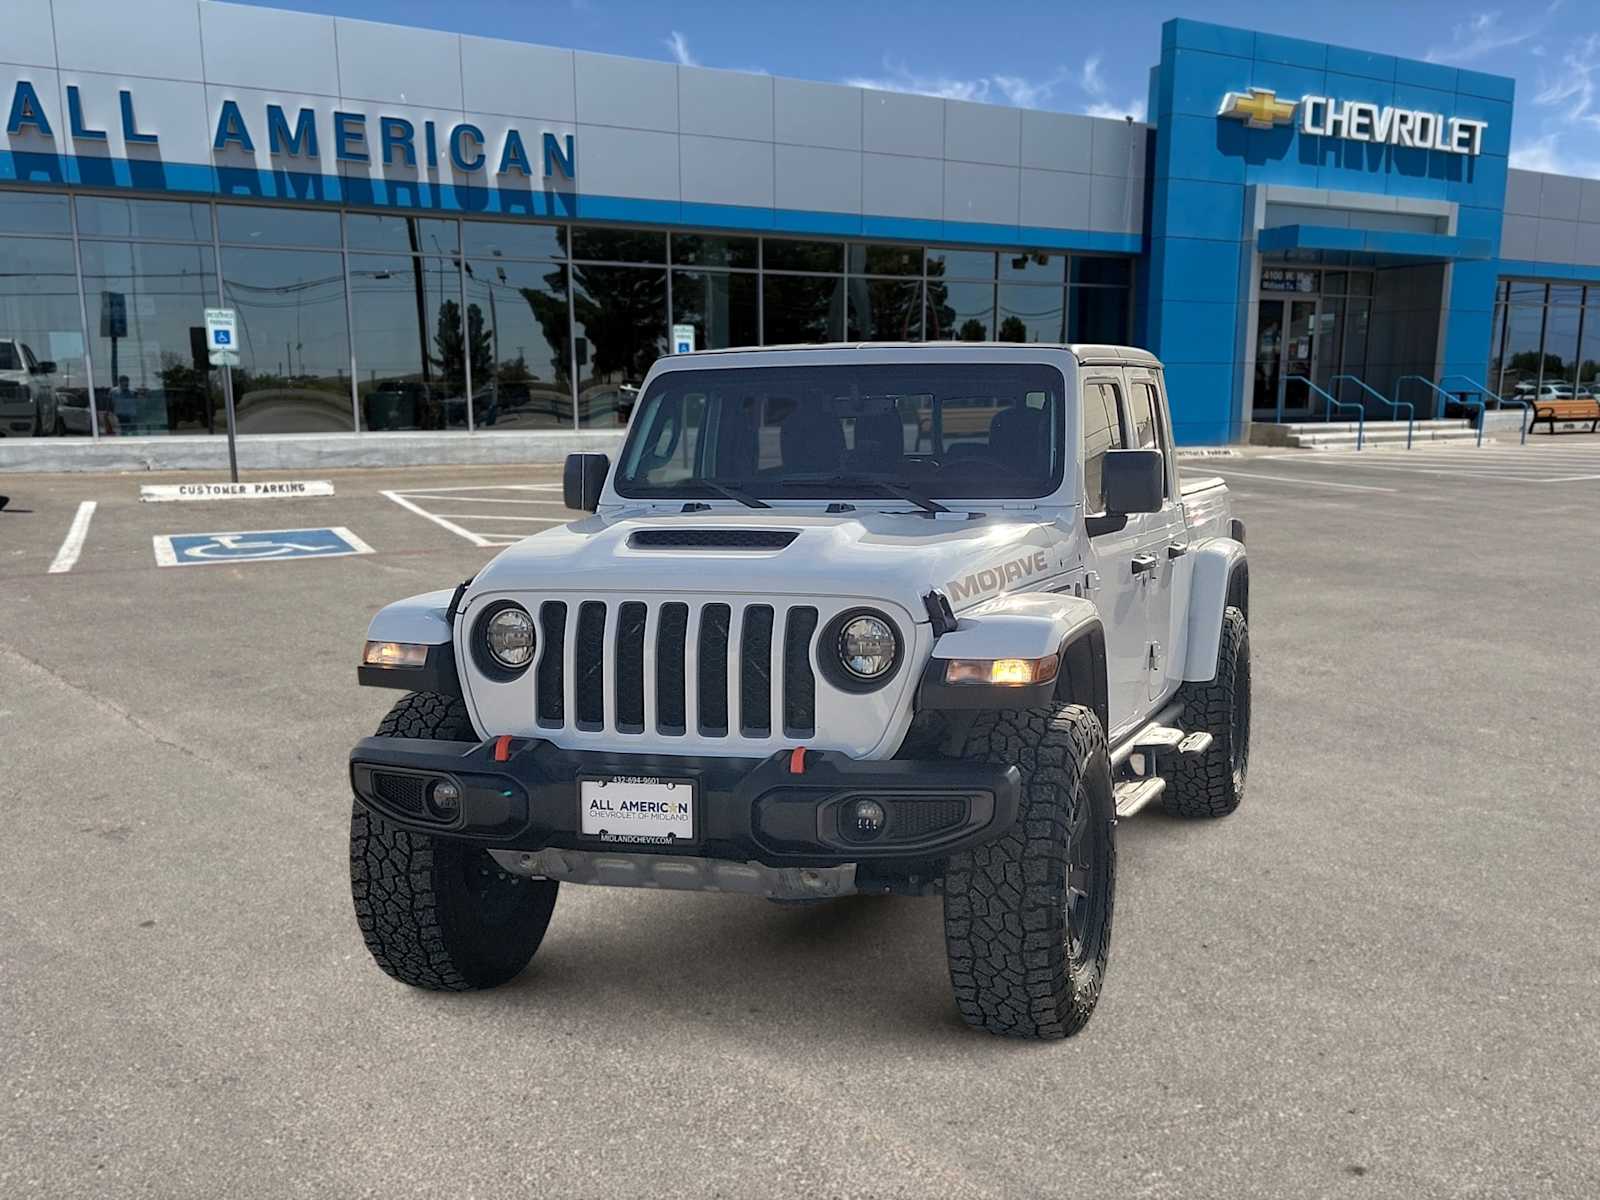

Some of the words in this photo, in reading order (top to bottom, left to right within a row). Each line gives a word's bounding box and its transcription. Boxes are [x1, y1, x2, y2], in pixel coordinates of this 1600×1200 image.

[6, 80, 159, 144] ALL
[213, 99, 576, 178] AMERICAN
[1301, 94, 1488, 156] CHEVROLET
[179, 485, 247, 495] CUSTOMER
[254, 482, 306, 493] PARKING
[946, 551, 1048, 601] MOJAVE
[590, 800, 614, 811] ALL
[620, 801, 688, 814] AMERICN
[590, 810, 635, 819] CHEVROLET
[639, 812, 649, 820] OF
[650, 812, 689, 821] MIDLAND
[601, 834, 673, 845] MIDLANDCHEVY.COM
